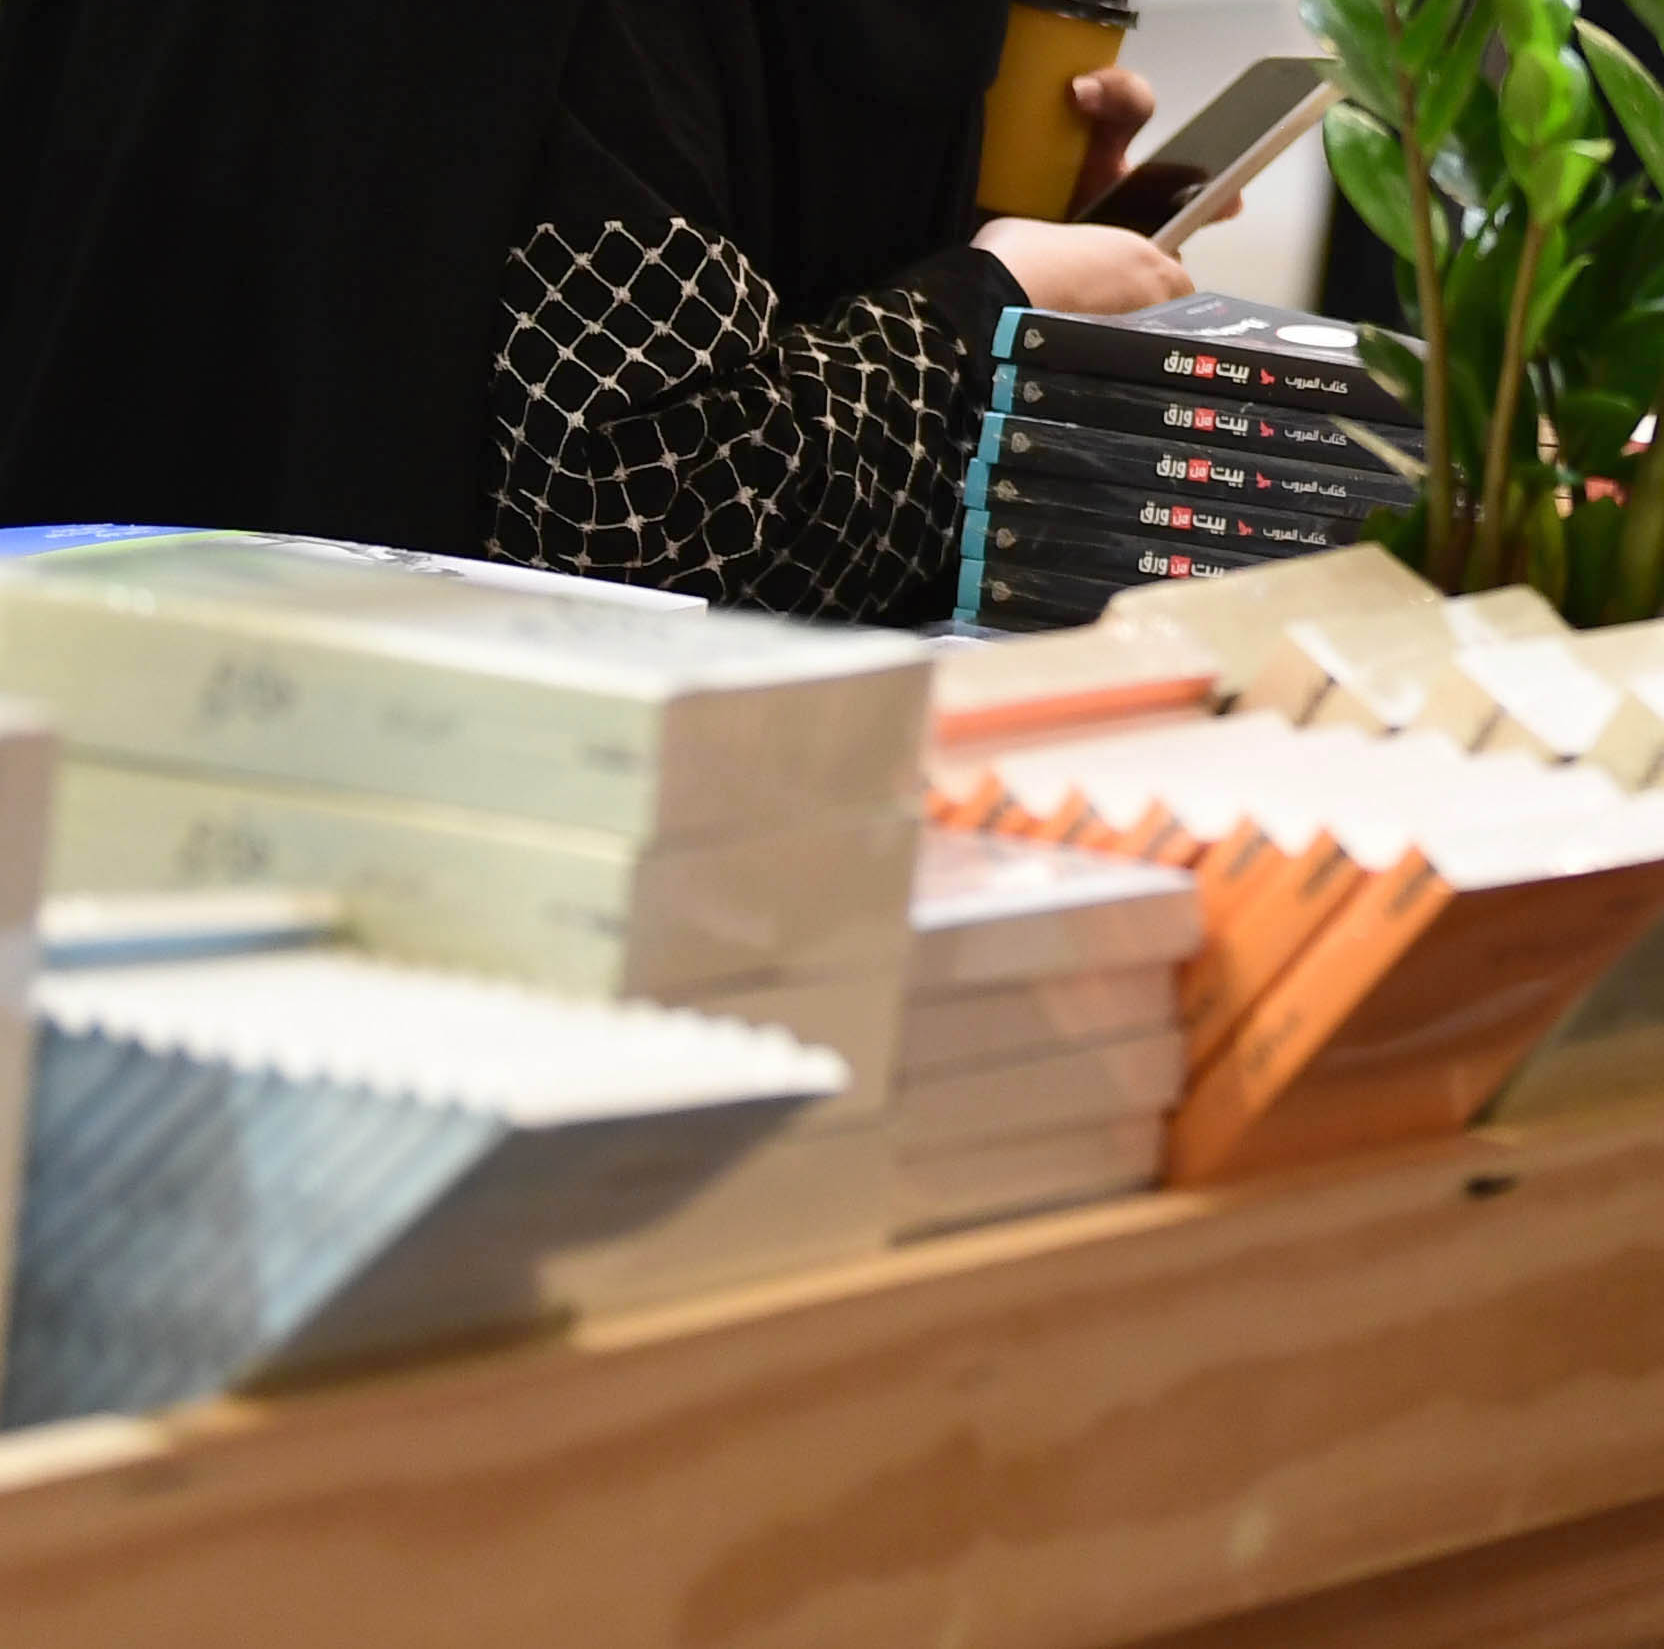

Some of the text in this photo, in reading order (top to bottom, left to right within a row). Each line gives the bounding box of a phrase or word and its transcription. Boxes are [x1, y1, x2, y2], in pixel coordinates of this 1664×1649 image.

[1163, 351, 1251, 383] بيت من ورق
[1284, 375, 1349, 395] كتاب الهروب
[1163, 403, 1249, 437] بيت من ورق
[1284, 427, 1348, 447] كتاب الهروب
[1156, 454, 1245, 487] بيت من ورق
[1281, 478, 1347, 498] كتاب الهروب
[1139, 502, 1227, 536] بيت من ورق
[1299, 529, 1327, 546] كتاب
[1138, 551, 1168, 576] ورق
[1170, 556, 1191, 577] من
